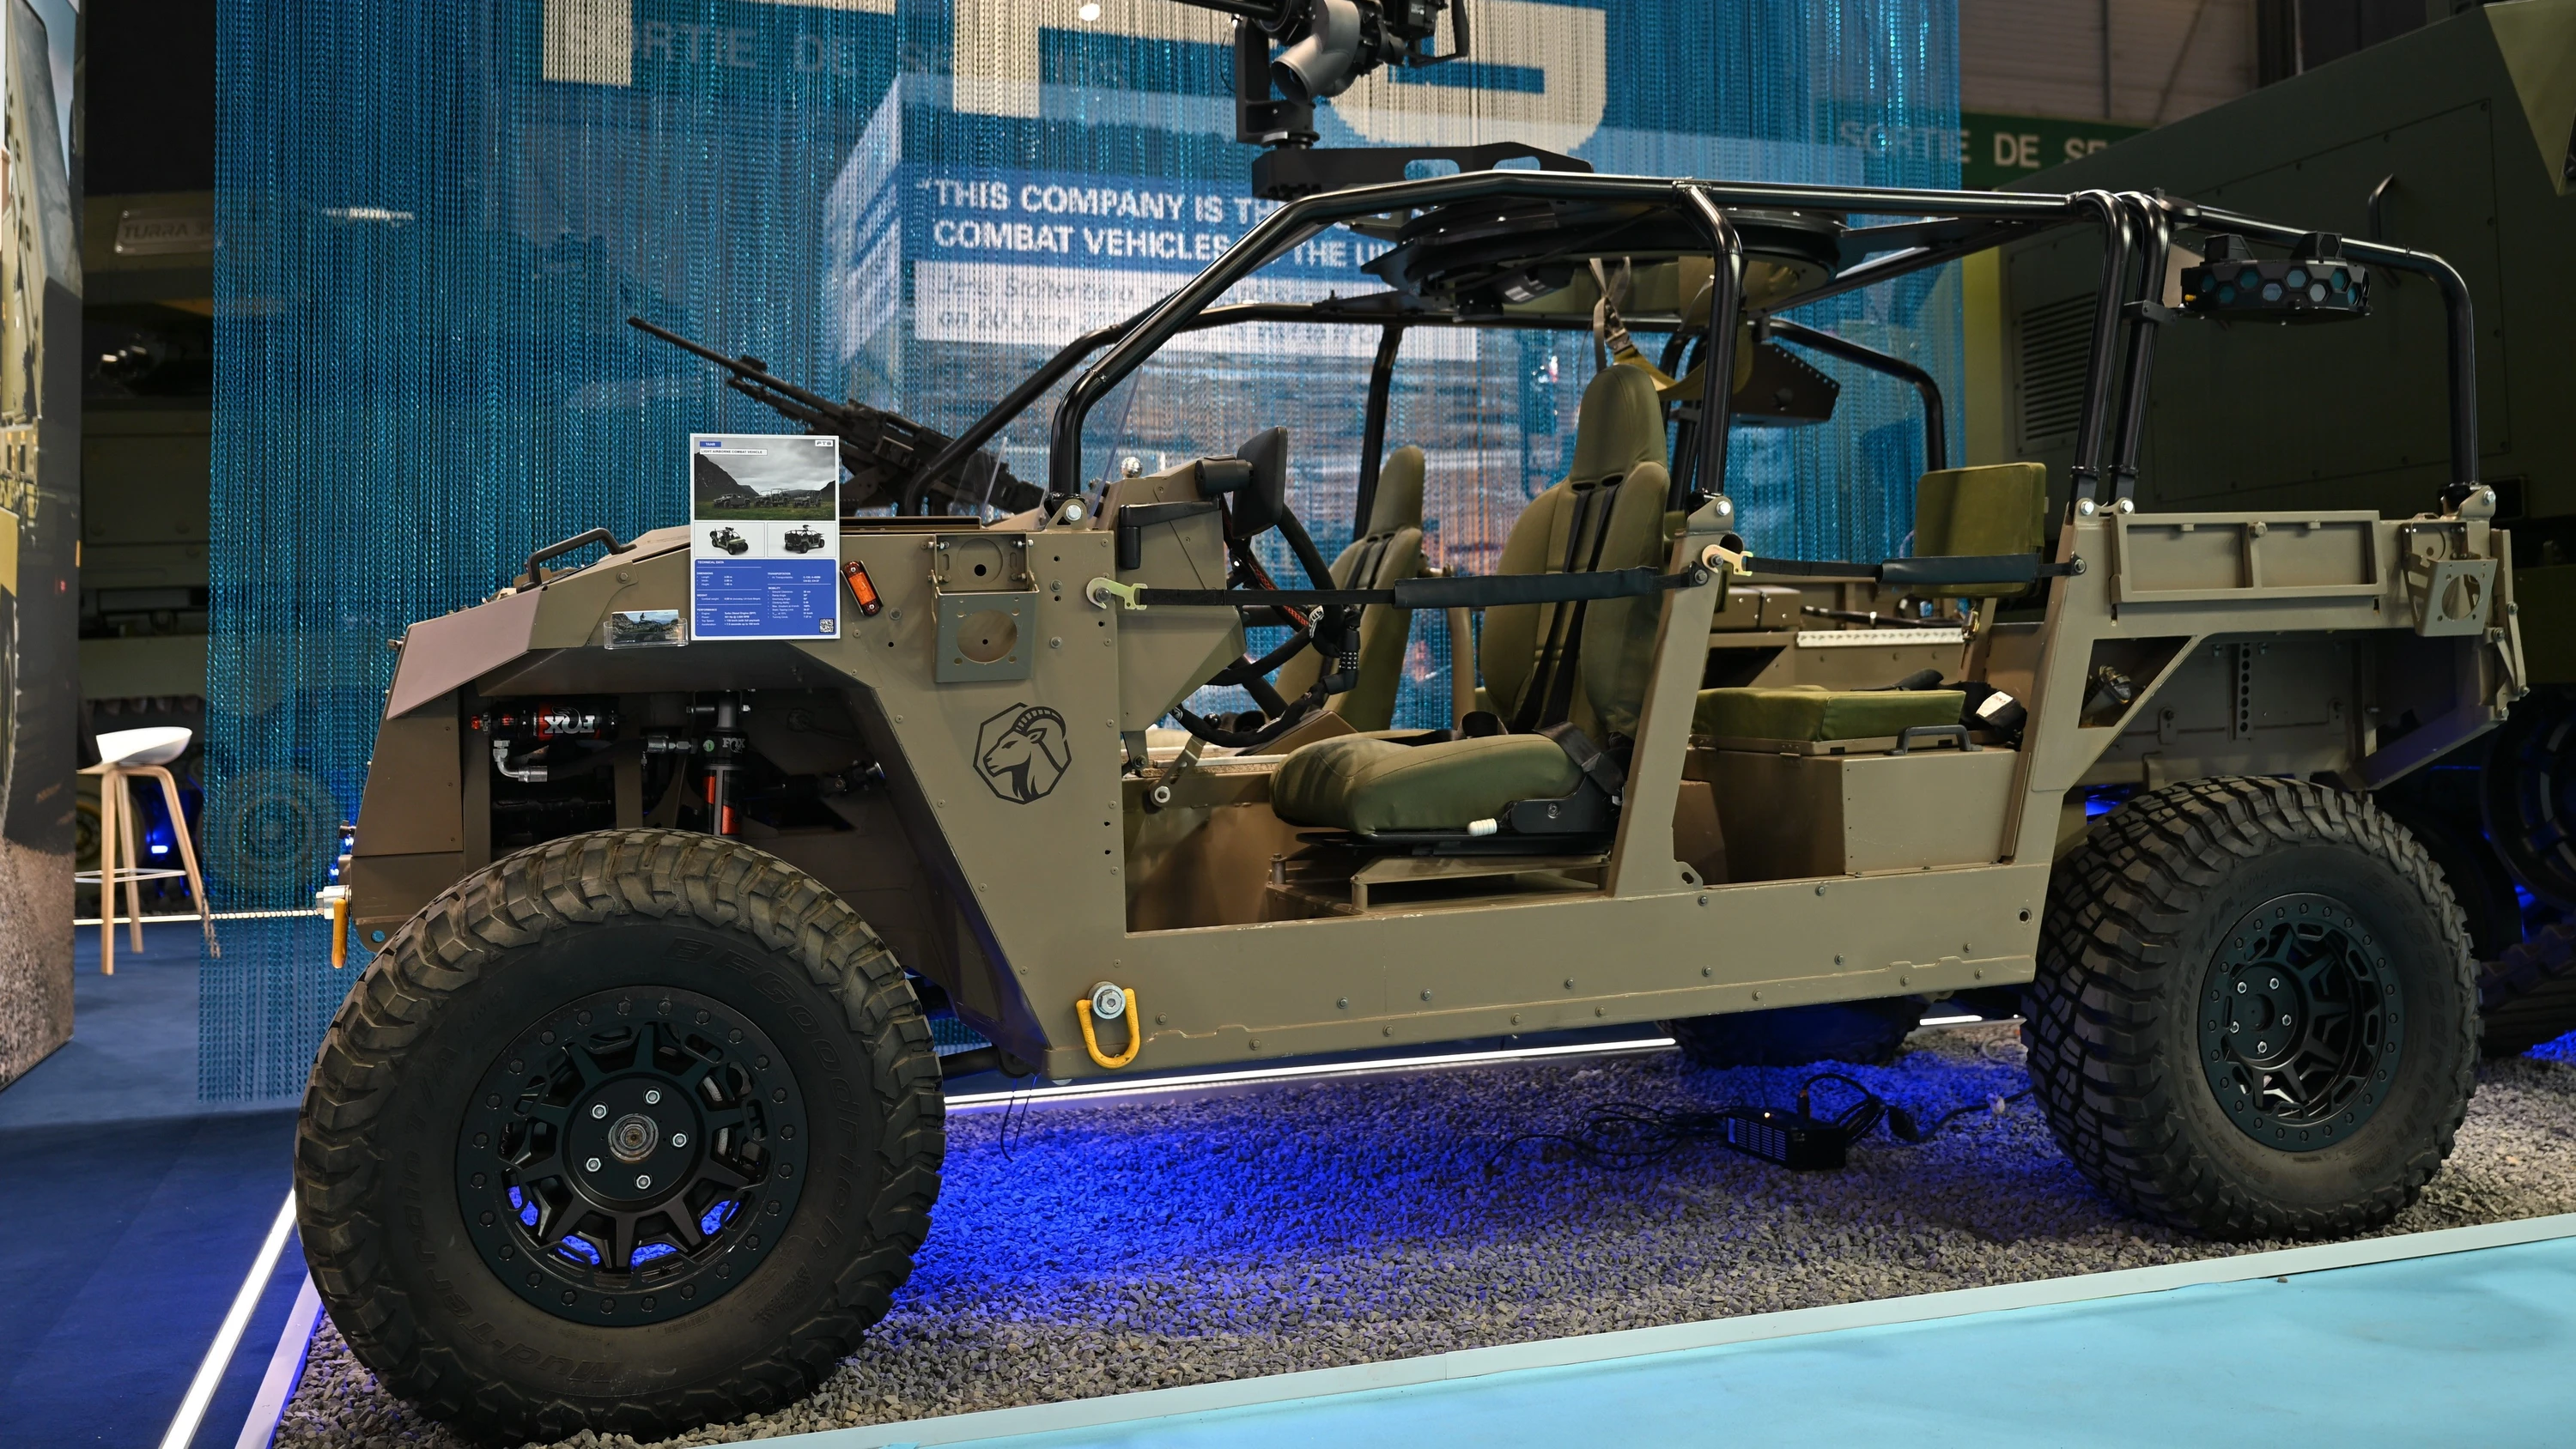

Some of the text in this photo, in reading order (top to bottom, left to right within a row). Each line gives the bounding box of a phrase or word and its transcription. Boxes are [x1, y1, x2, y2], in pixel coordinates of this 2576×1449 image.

[1994, 132, 2042, 169] DE
[1020, 185, 1185, 221] COMPANY
[1194, 195, 1224, 223] IS
[934, 221, 1076, 255] COMBAT
[1293, 239, 1346, 267] THE
[544, 707, 595, 734] FOX
[722, 737, 746, 754] FOX
